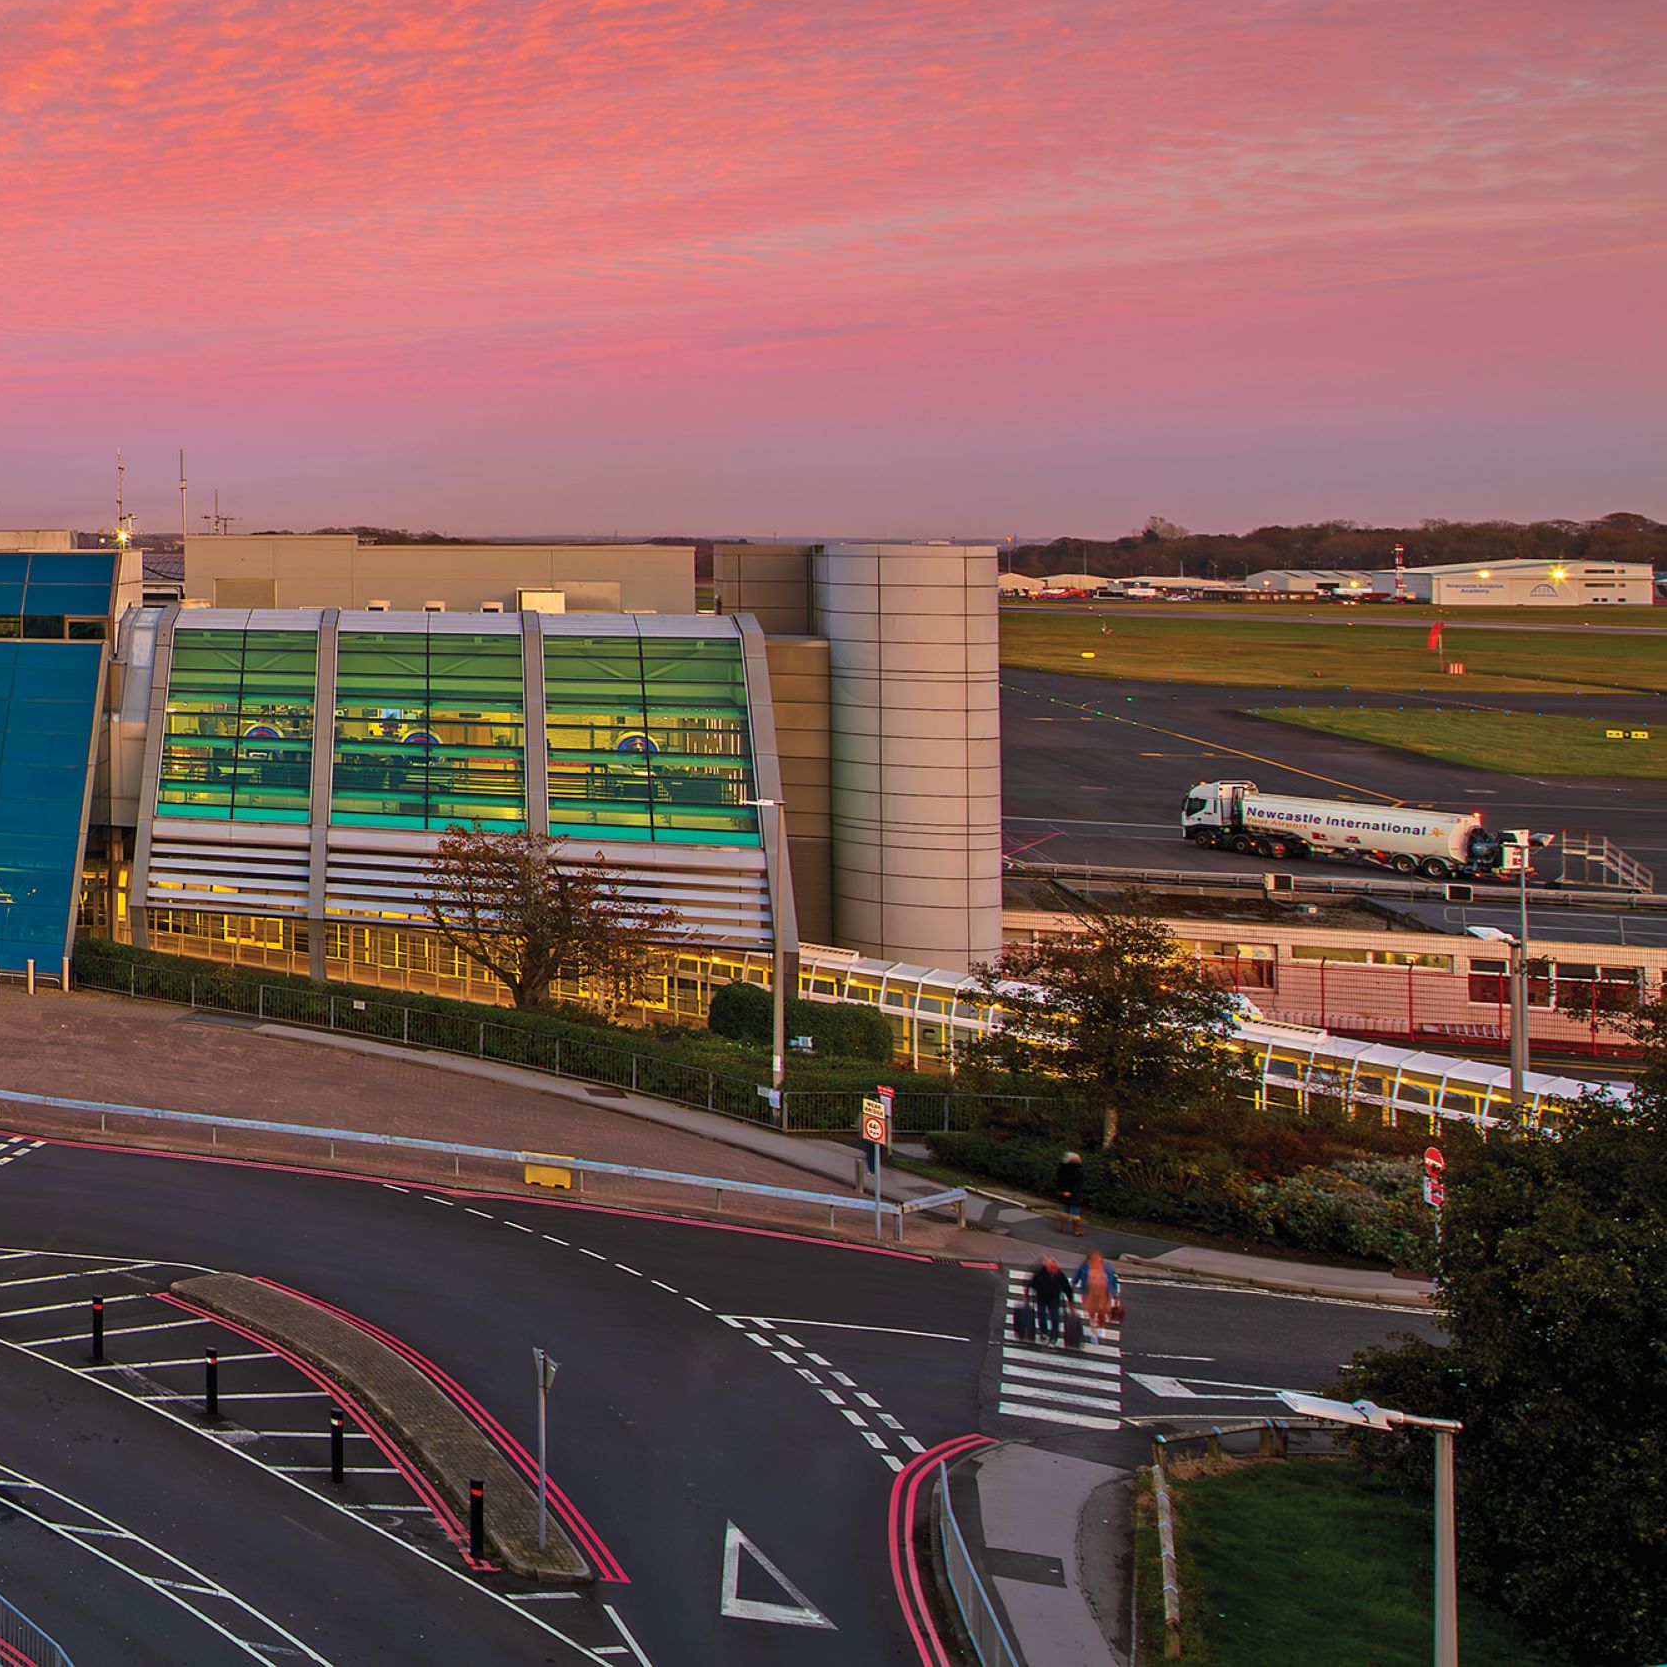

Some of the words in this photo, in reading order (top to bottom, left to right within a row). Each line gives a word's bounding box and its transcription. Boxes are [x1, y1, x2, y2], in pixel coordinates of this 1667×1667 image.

[1245, 806, 1322, 825] Newcastle
[1325, 815, 1427, 837] International
[1245, 816, 1269, 826] Your
[1272, 819, 1309, 830] Airport
[864, 1106, 884, 1117] BRIDGE
[866, 1101, 881, 1110] WEAK
